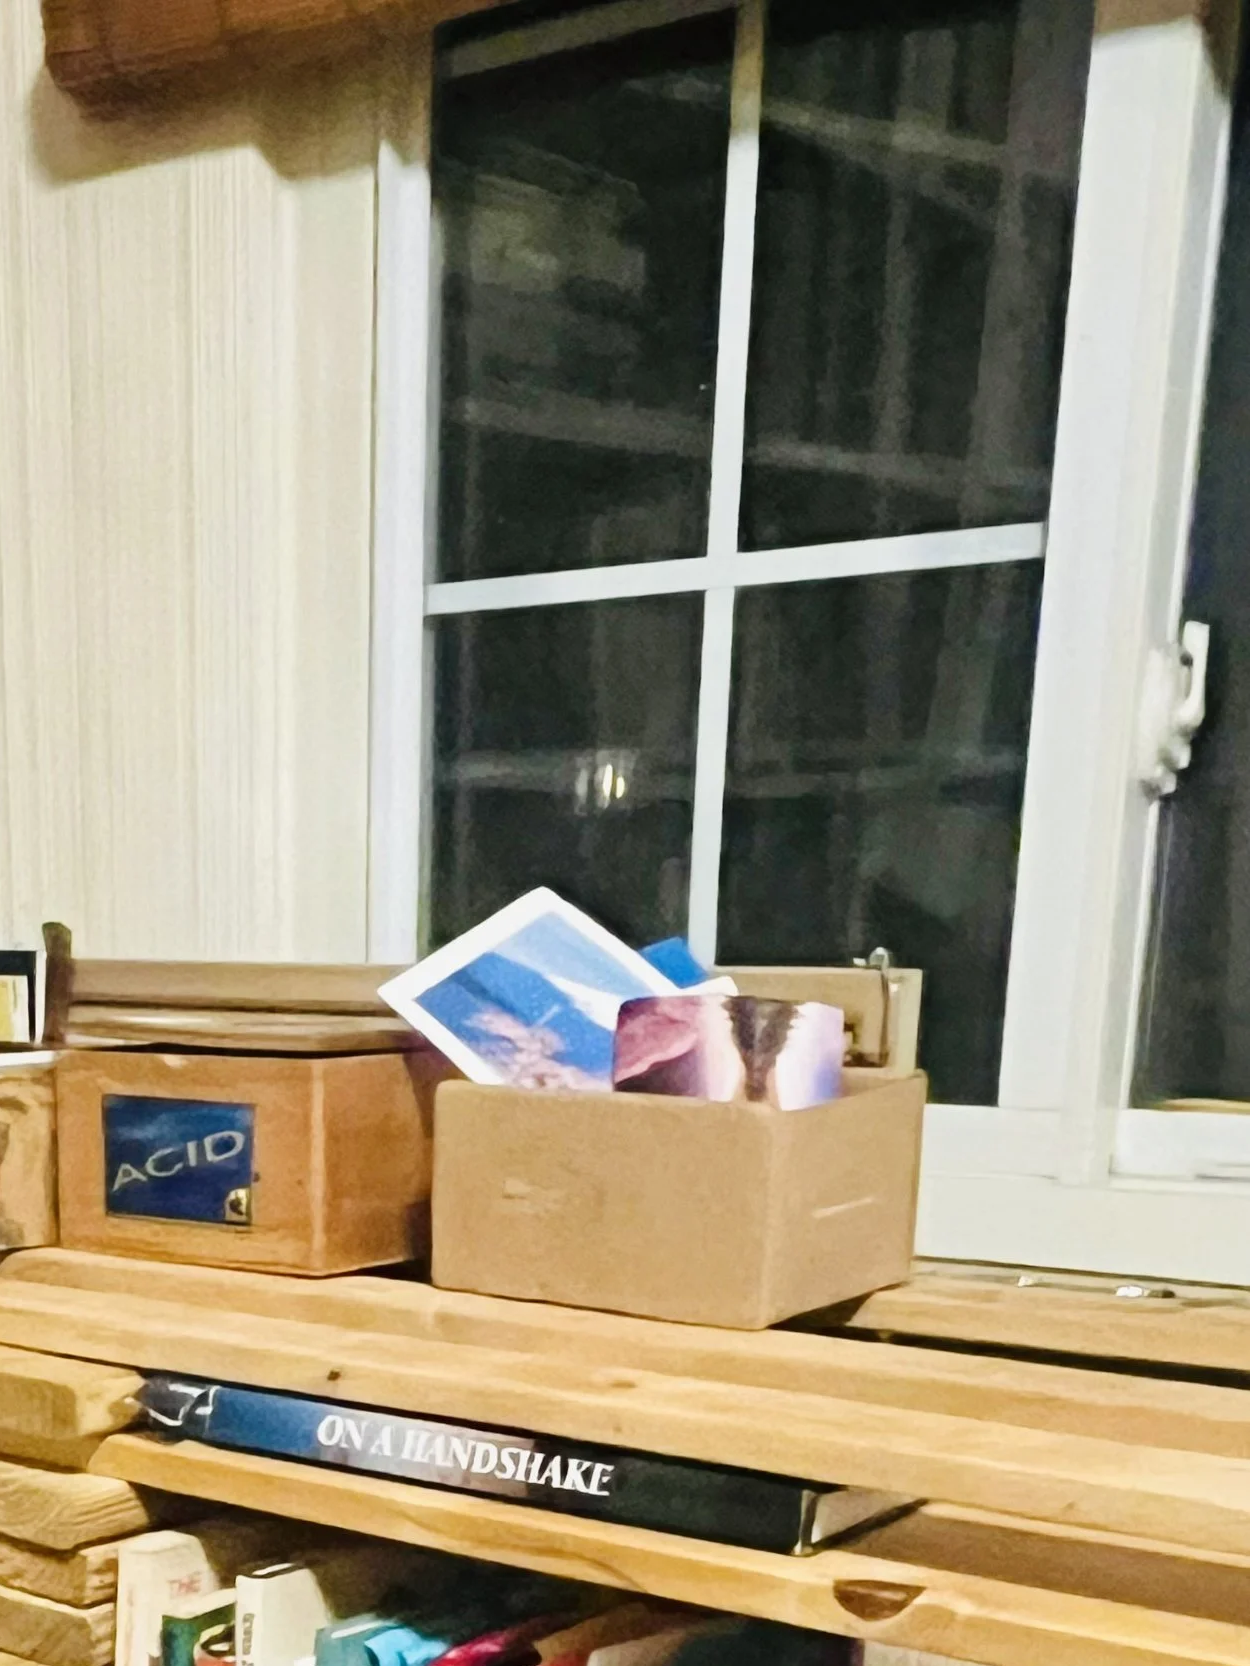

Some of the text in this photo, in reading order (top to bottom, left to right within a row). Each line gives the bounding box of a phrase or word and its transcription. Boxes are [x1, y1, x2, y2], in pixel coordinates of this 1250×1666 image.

[113, 1130, 246, 1192] ACID
[316, 1414, 616, 1498] ON A HANDSHAKE
